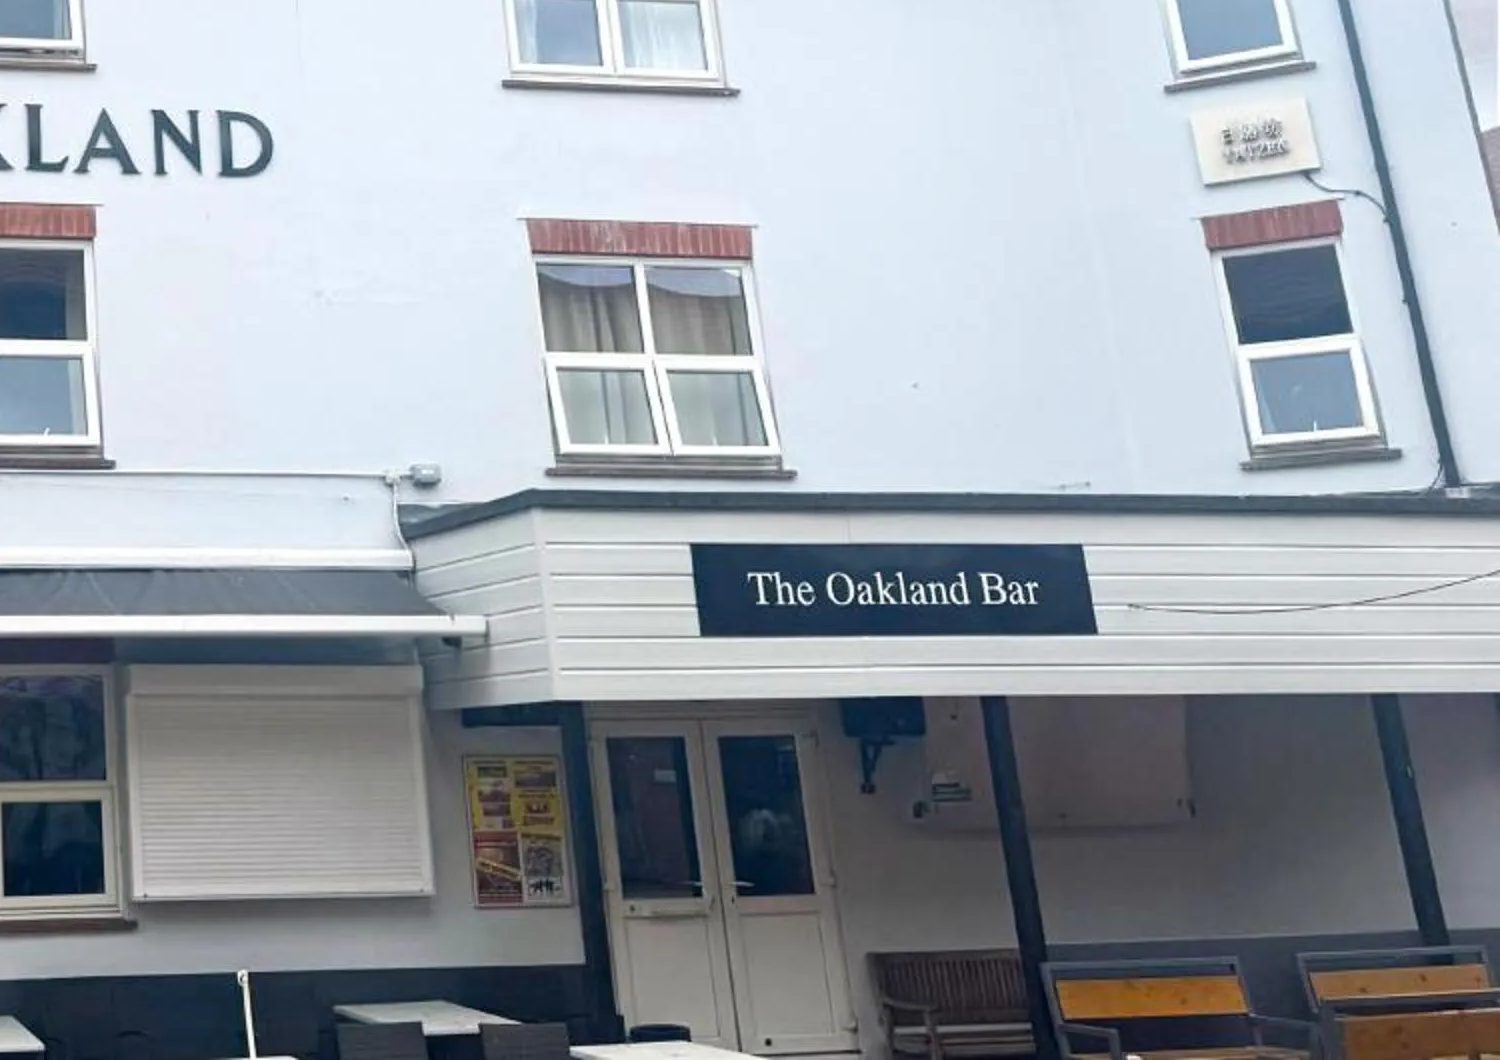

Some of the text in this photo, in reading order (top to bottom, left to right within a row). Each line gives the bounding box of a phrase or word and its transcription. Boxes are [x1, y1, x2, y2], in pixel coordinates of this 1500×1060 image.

[746, 571, 1040, 606] The Oakland Bar
